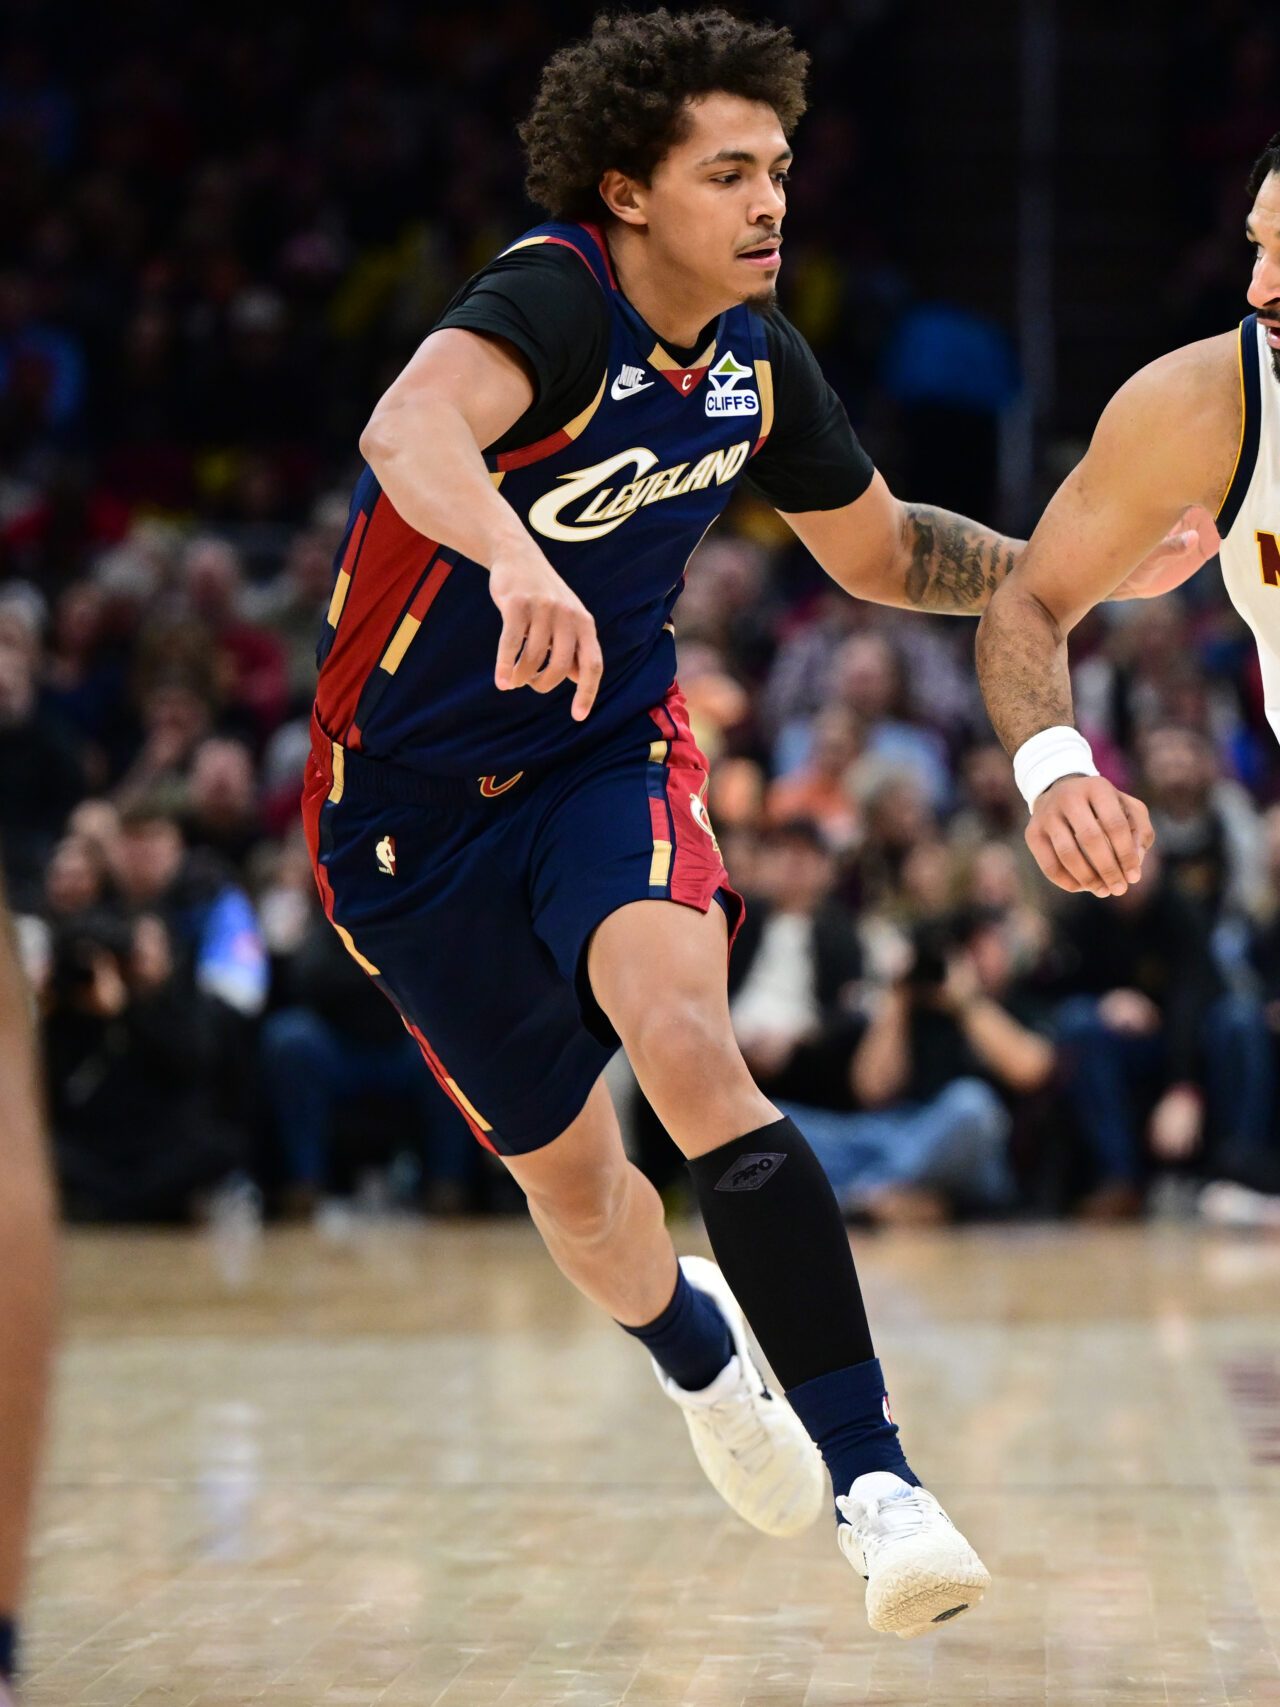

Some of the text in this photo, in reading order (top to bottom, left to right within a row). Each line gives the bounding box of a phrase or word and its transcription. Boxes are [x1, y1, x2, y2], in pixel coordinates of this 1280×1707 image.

[618, 363, 646, 388] NIKE
[681, 374, 692, 391] C
[707, 395, 757, 412] CLIFFS
[528, 440, 750, 542] CLEVELAND
[732, 1158, 773, 1187] PRO
